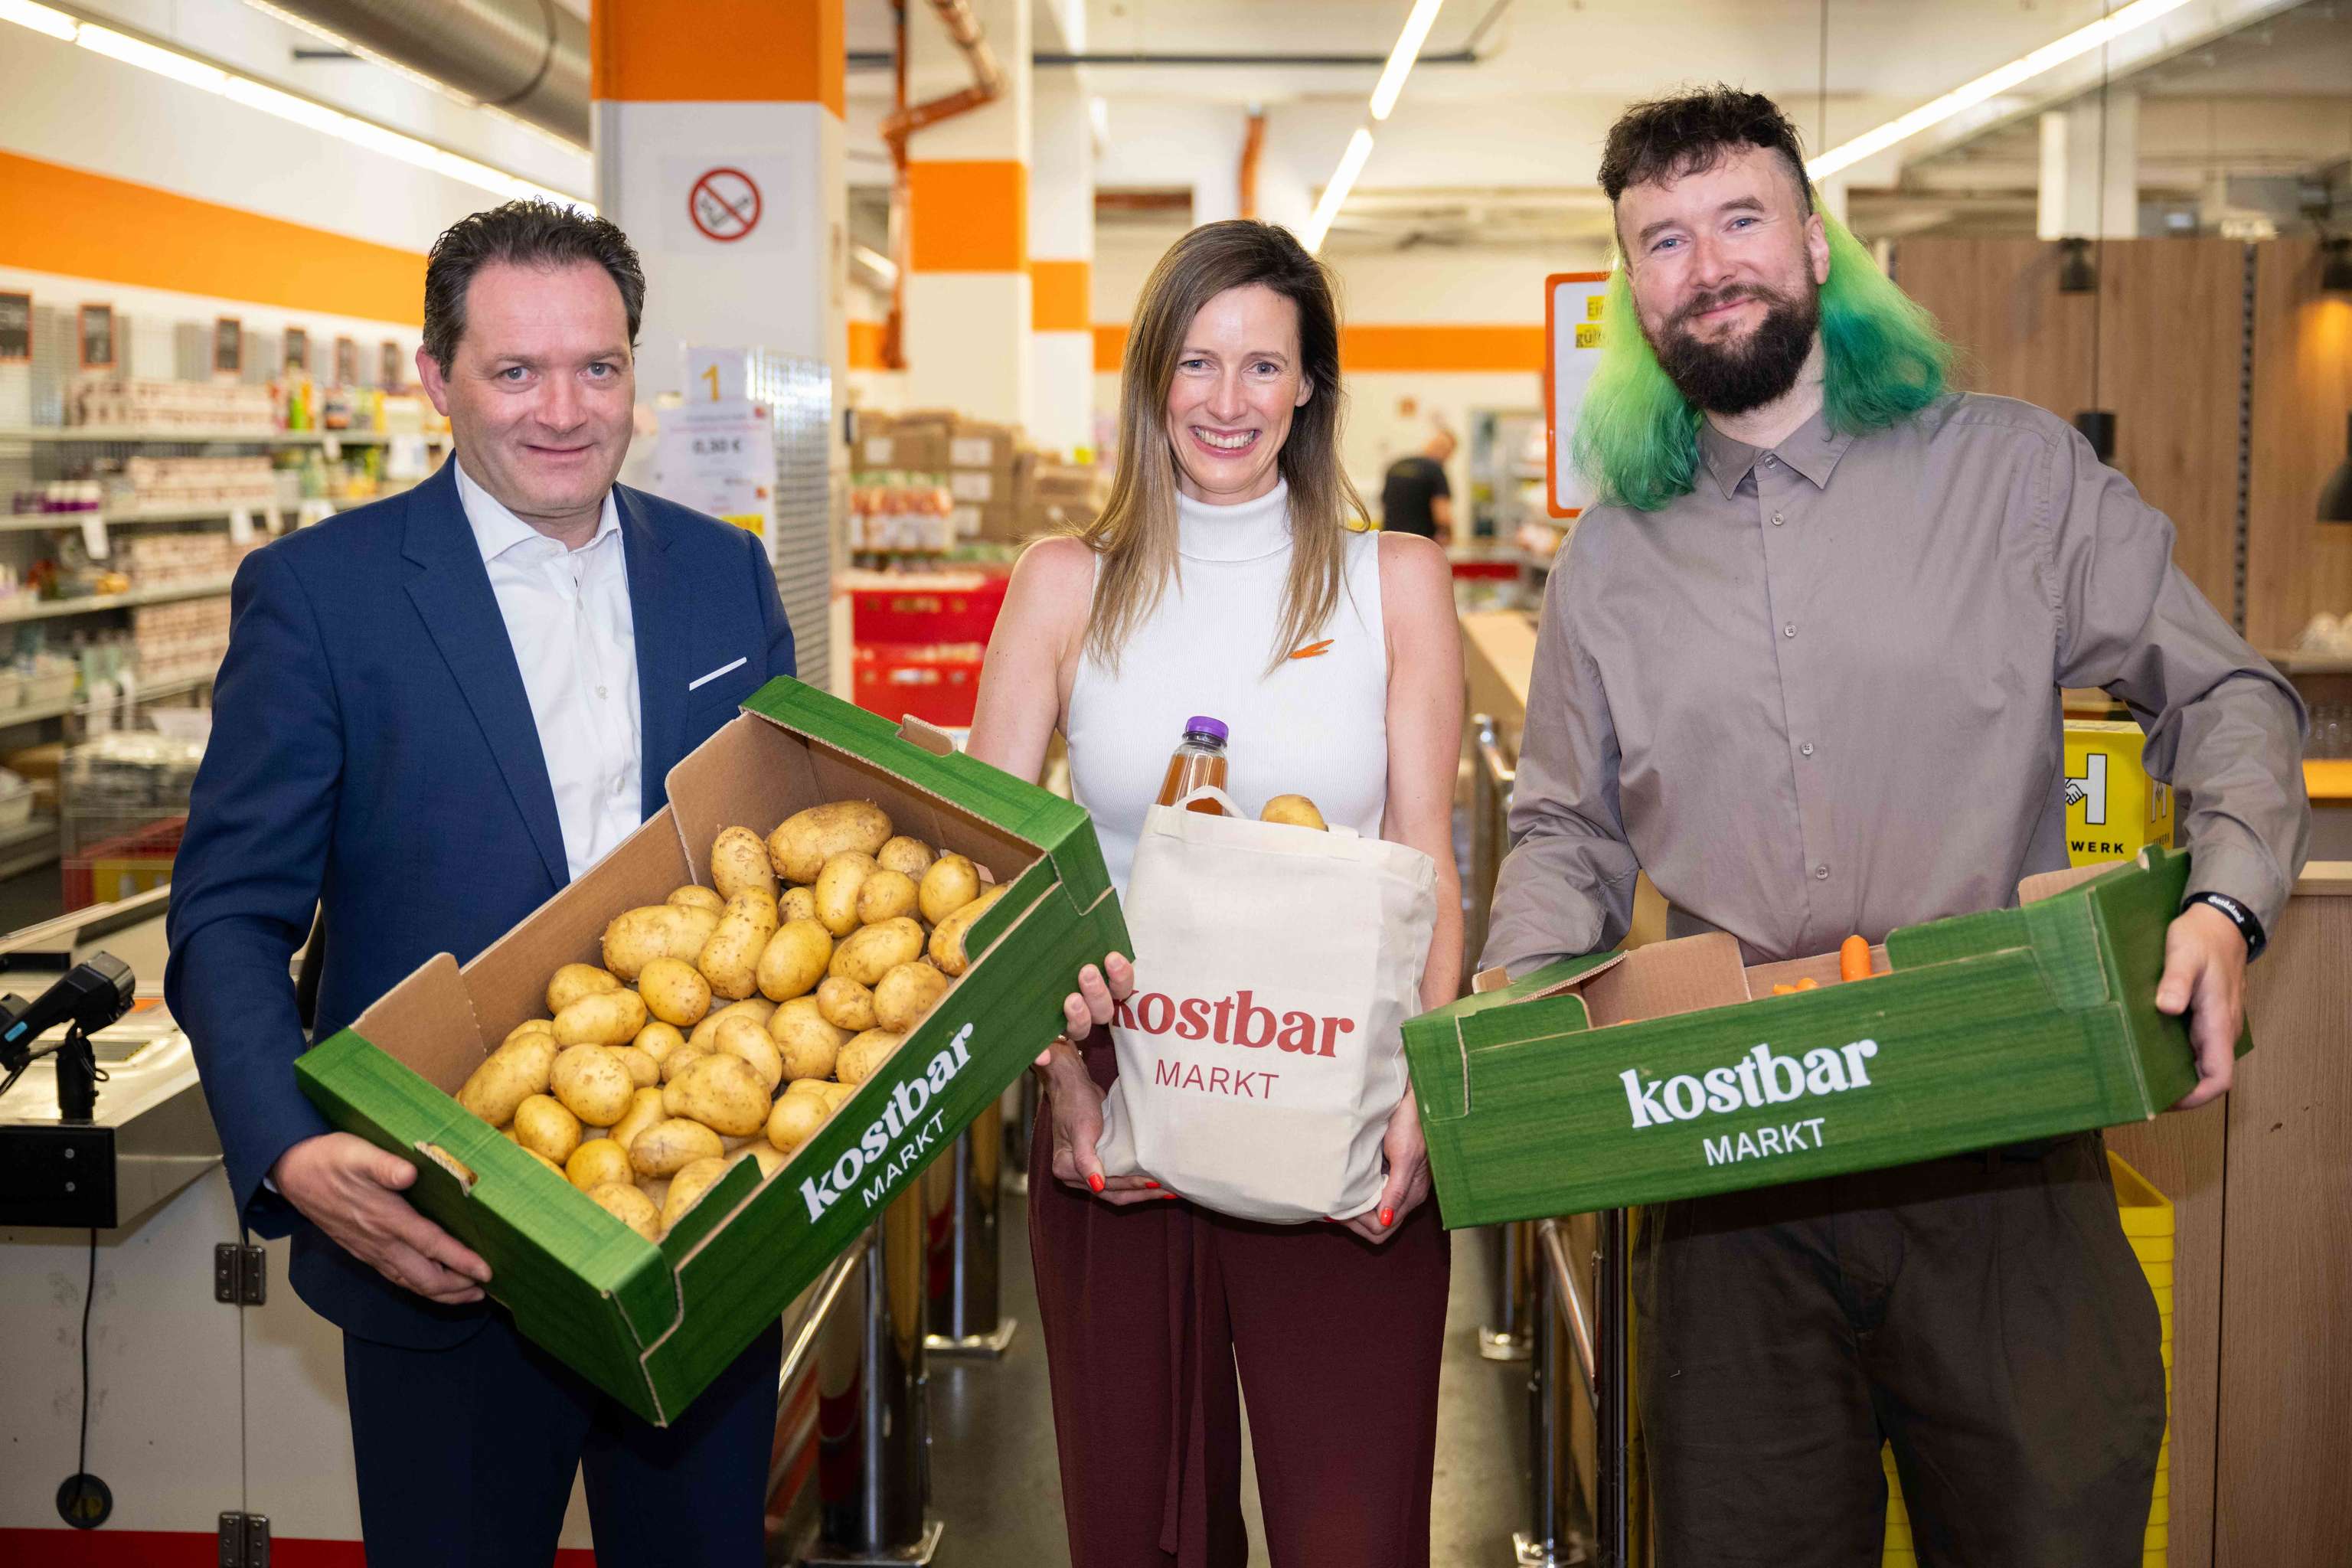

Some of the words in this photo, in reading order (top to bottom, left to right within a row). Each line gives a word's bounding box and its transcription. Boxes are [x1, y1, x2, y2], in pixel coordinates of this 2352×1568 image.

[701, 364, 721, 402] 1
[1112, 989, 1355, 1058] kostbar
[1155, 1059, 1279, 1099] MARKT
[1619, 1038, 1878, 1129] kostbar
[799, 1022, 974, 1224] kostbar
[1702, 1117, 1826, 1167] MARKT
[862, 1109, 944, 1208] MARKT
